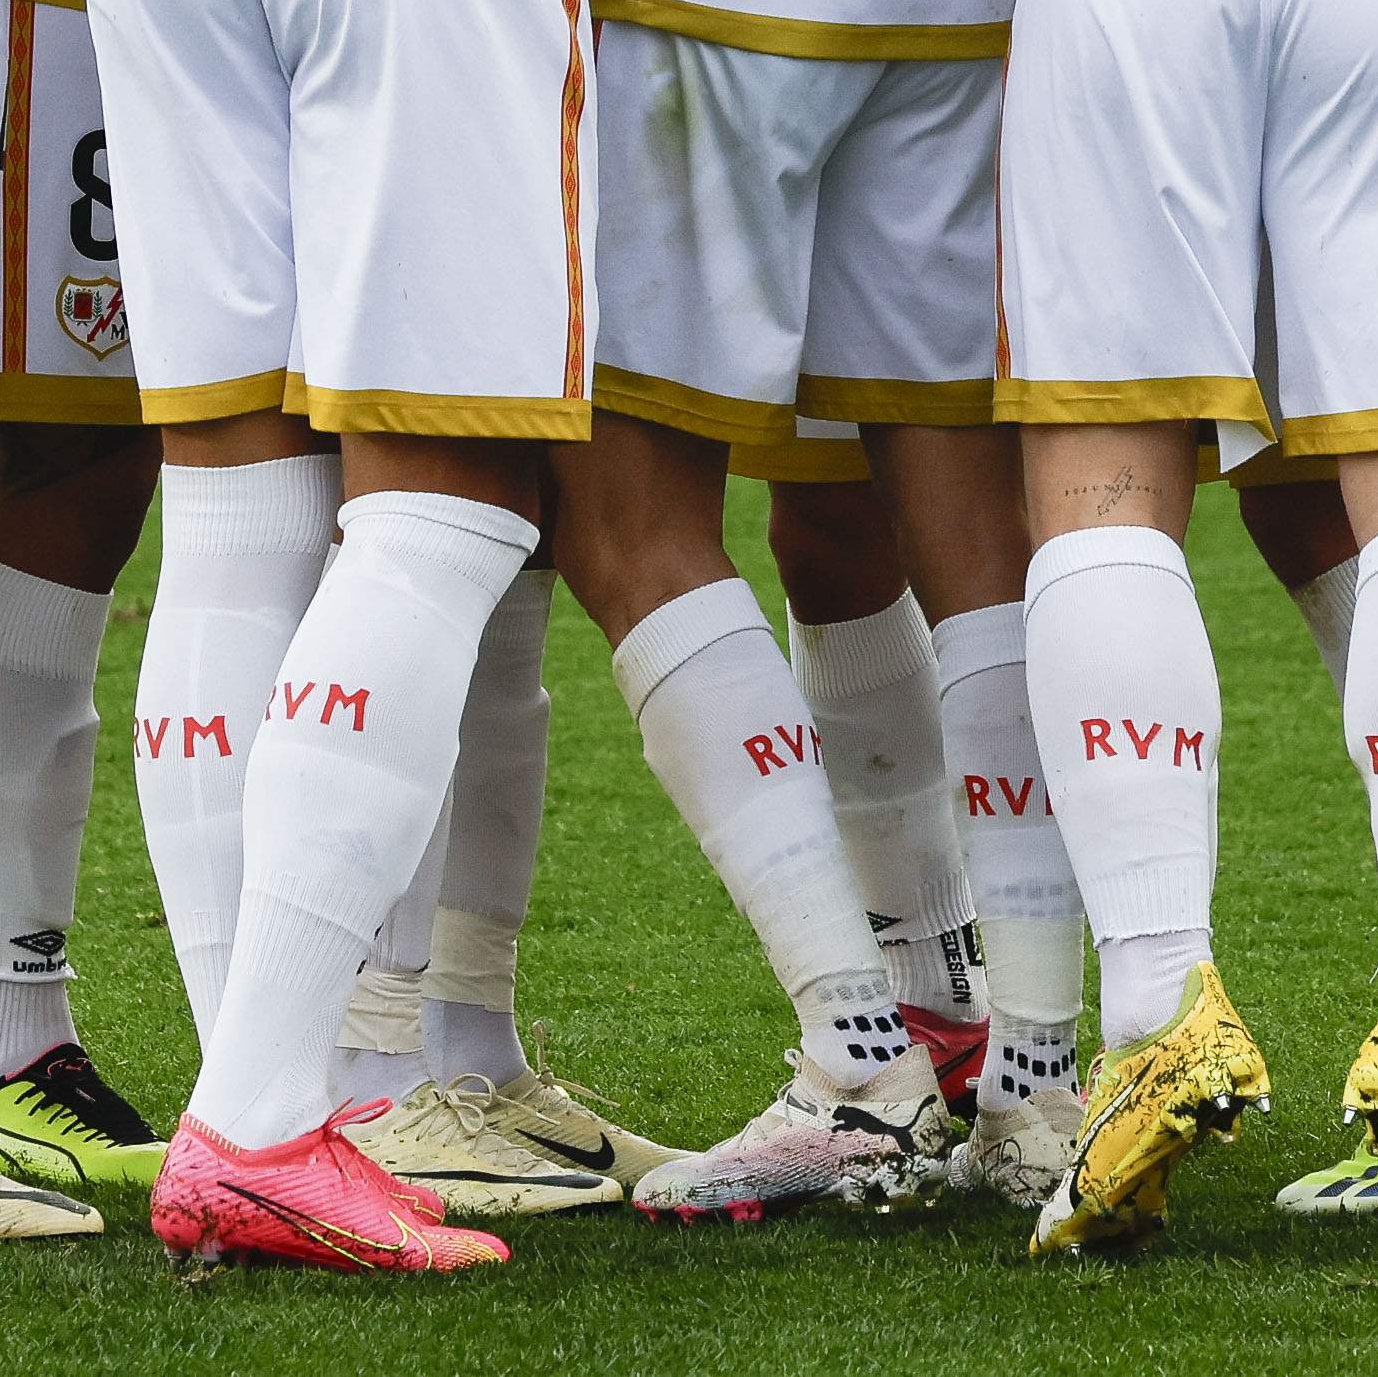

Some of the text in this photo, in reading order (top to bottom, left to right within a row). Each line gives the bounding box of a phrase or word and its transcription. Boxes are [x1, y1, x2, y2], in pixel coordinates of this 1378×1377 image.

[265, 682, 371, 732] VM
[1080, 718, 1205, 771] RVM
[964, 775, 1054, 816] RV
